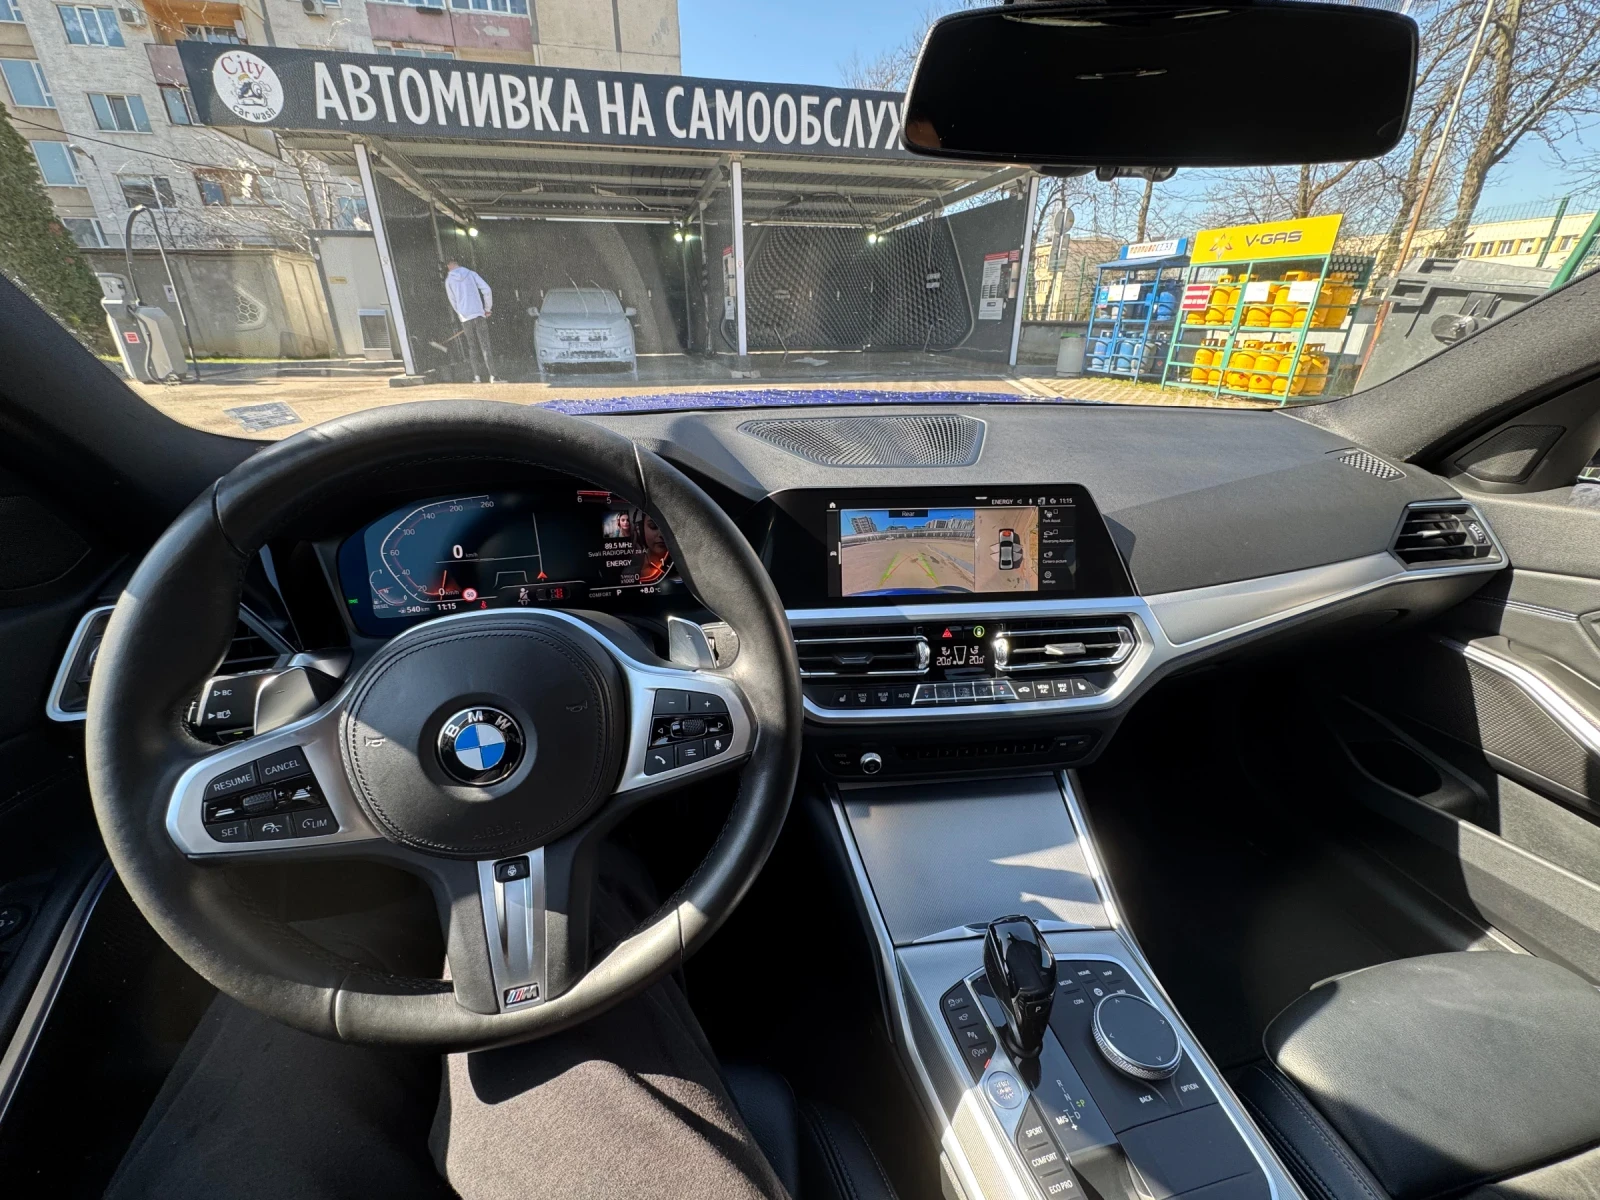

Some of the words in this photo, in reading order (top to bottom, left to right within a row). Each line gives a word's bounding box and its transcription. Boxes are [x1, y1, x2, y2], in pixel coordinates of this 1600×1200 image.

[220, 54, 266, 80] City
[314, 61, 590, 134] АВТОМИВКА
[597, 80, 656, 137] НА
[232, 104, 250, 118] car
[252, 107, 276, 120] wash
[452, 544, 463, 558] 0
[444, 710, 512, 738] BMW
[265, 760, 299, 775] CANCEL
[213, 773, 252, 792] RESUME
[312, 818, 328, 828] LIM
[221, 827, 239, 837] SET
[1180, 1083, 1199, 1092] OPTION
[1139, 1095, 1153, 1103] BACK
[1074, 1111, 1081, 1119] D
[1026, 1126, 1043, 1137] SPORT
[1032, 1152, 1058, 1167] COMFORT
[1048, 1184, 1062, 1194] ECO
[1061, 1180, 1073, 1190] PRO
